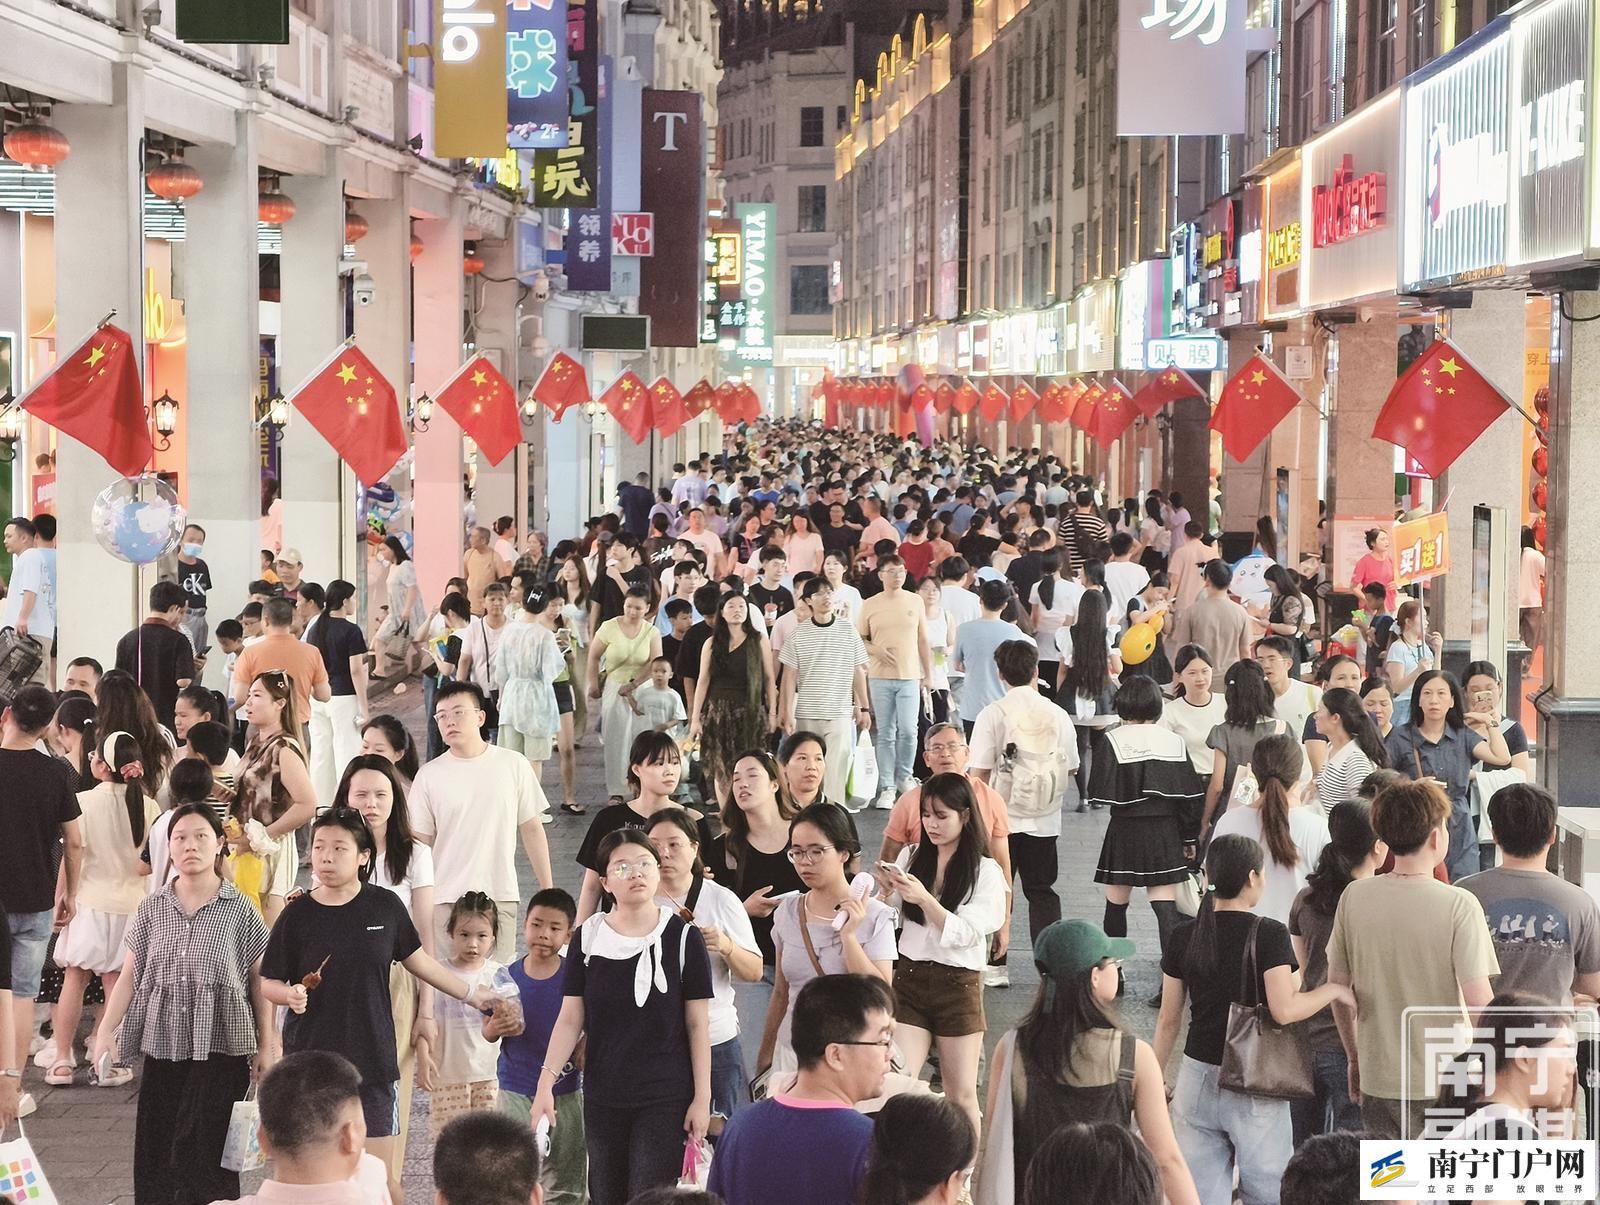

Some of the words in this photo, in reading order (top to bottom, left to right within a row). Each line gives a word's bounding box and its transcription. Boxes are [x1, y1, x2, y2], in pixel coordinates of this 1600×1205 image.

[540, 123, 560, 139] 2F
[653, 112, 687, 151] T
[1155, 344, 1210, 364] 贴膜
[1400, 531, 1443, 576] 买1送1
